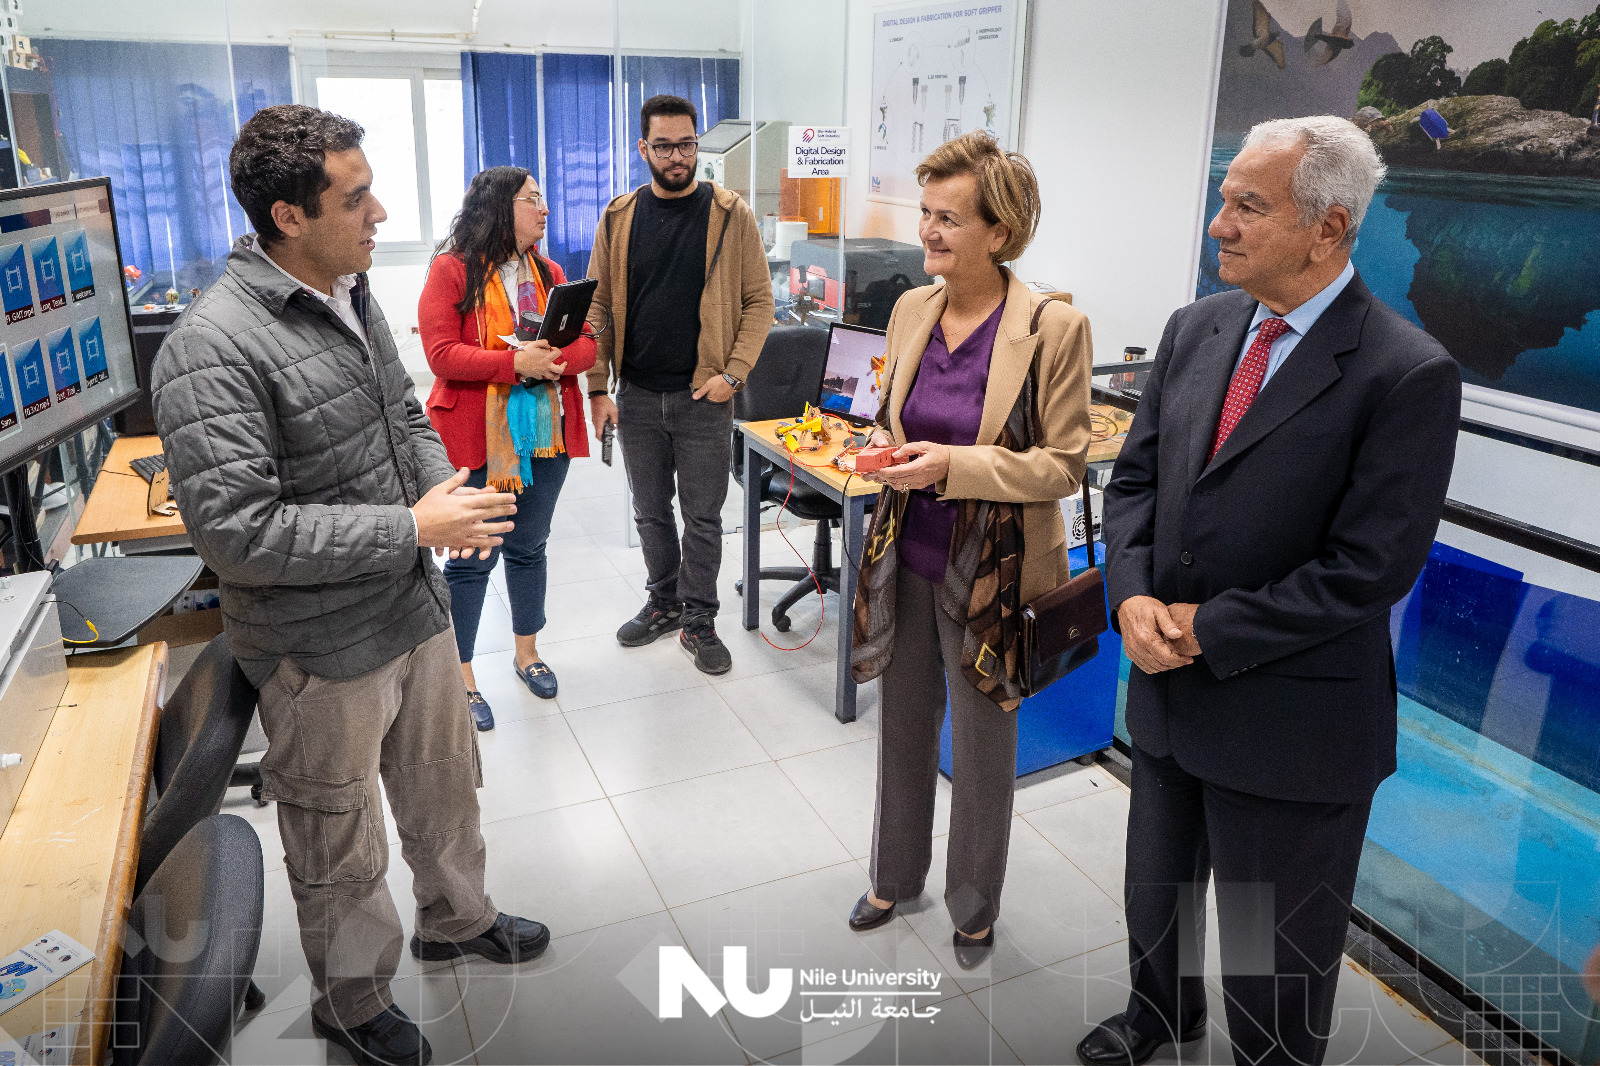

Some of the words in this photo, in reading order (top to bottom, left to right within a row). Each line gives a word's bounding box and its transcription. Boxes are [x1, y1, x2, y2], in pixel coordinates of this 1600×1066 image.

[921, 12, 952, 23] FABRICATION
[953, 10, 963, 18] FOR
[964, 8, 978, 17] SOFT
[979, 5, 1002, 15] GRIPPER
[796, 147, 819, 156] Digital
[821, 147, 845, 156] Design
[797, 157, 804, 165] &
[805, 157, 843, 165] Fabrication
[811, 168, 829, 176] Area
